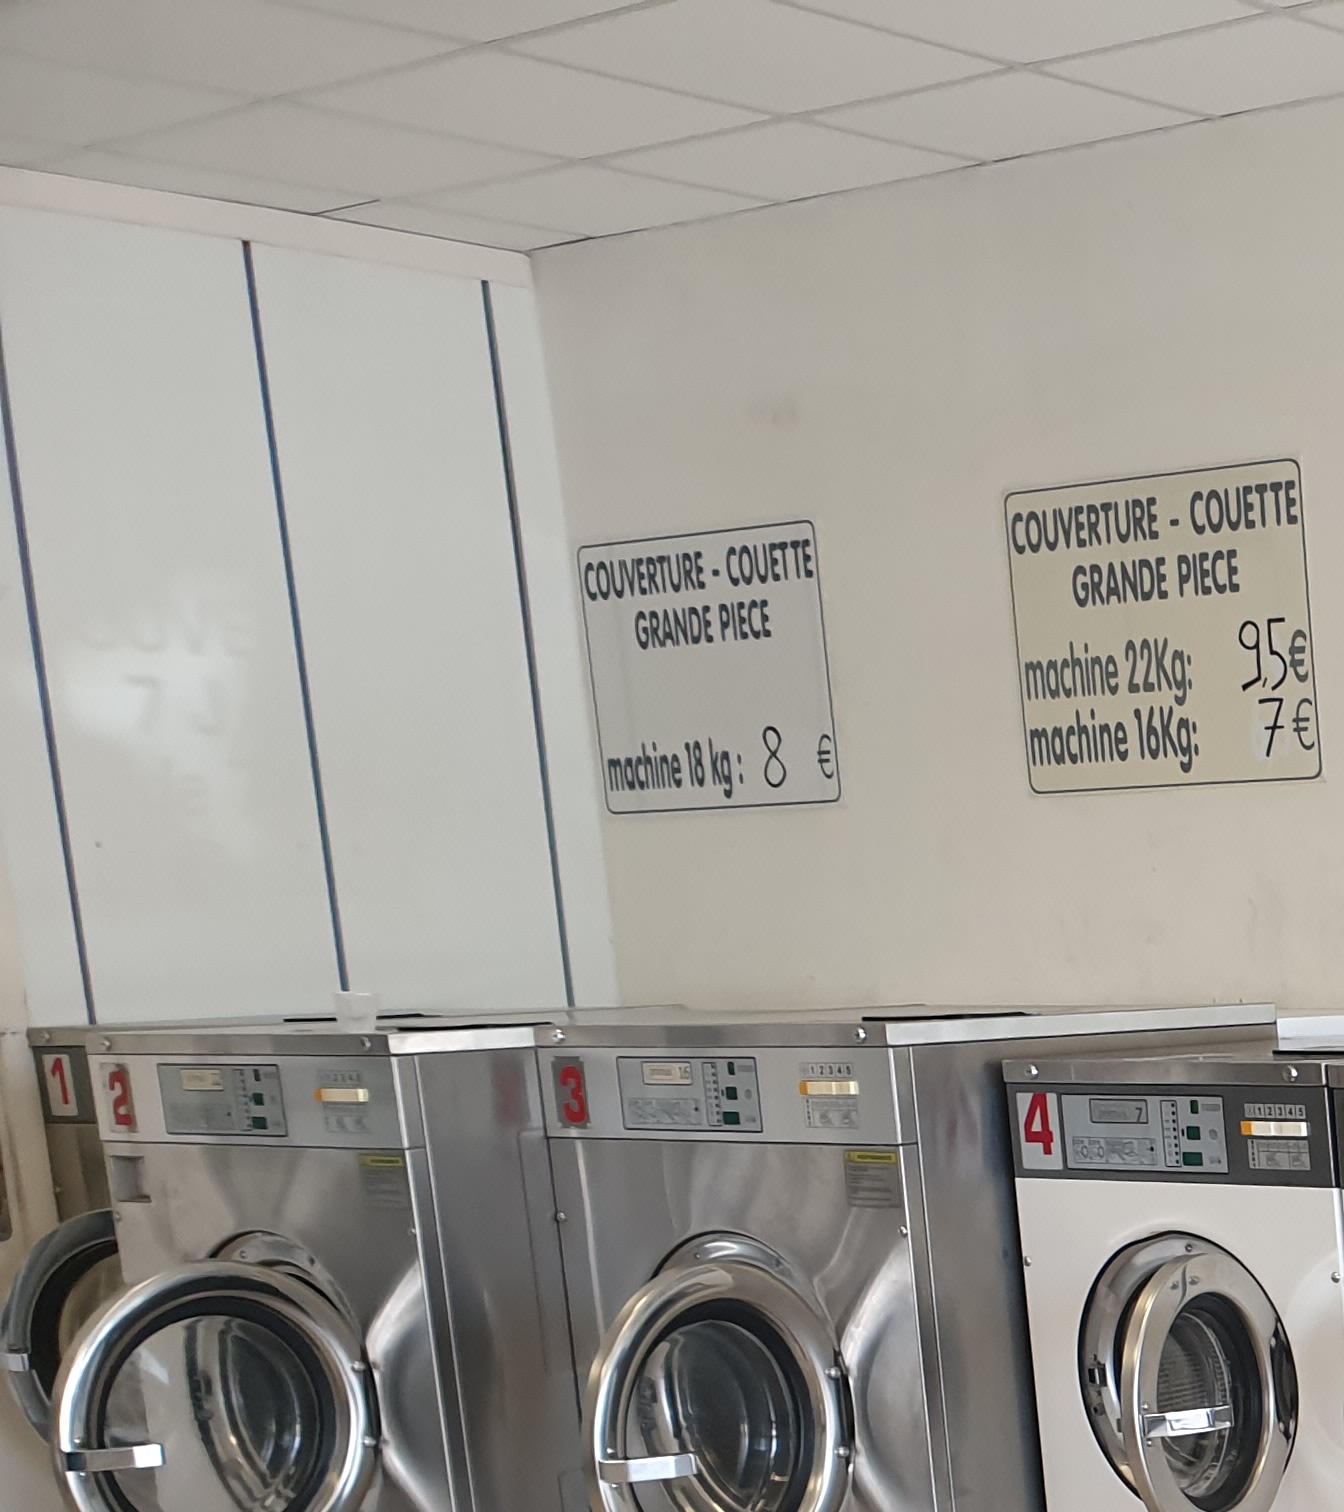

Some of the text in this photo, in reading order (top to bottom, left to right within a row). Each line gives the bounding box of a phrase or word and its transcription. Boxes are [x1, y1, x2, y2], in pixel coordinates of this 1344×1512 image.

[1011, 480, 1298, 555] COUVERTURE - COUETTE
[584, 539, 813, 601] COUVERTURE - COUETTE
[1072, 549, 1239, 608] GRANDE PIECE
[634, 599, 772, 650] GRANDE PIECE
[1024, 640, 1118, 700] machine
[1124, 637, 1193, 706] 22Kg:
[608, 742, 682, 791] machine
[684, 740, 705, 788] 18
[762, 726, 787, 788] 8
[817, 734, 834, 779] €
[1030, 698, 1315, 773] machine 16Kg: 7 €
[51, 1057, 70, 1105] 1
[108, 1070, 133, 1126] 2
[559, 1066, 587, 1124] 3
[1024, 1093, 1053, 1155] 4
[1135, 1107, 1143, 1121] 7
